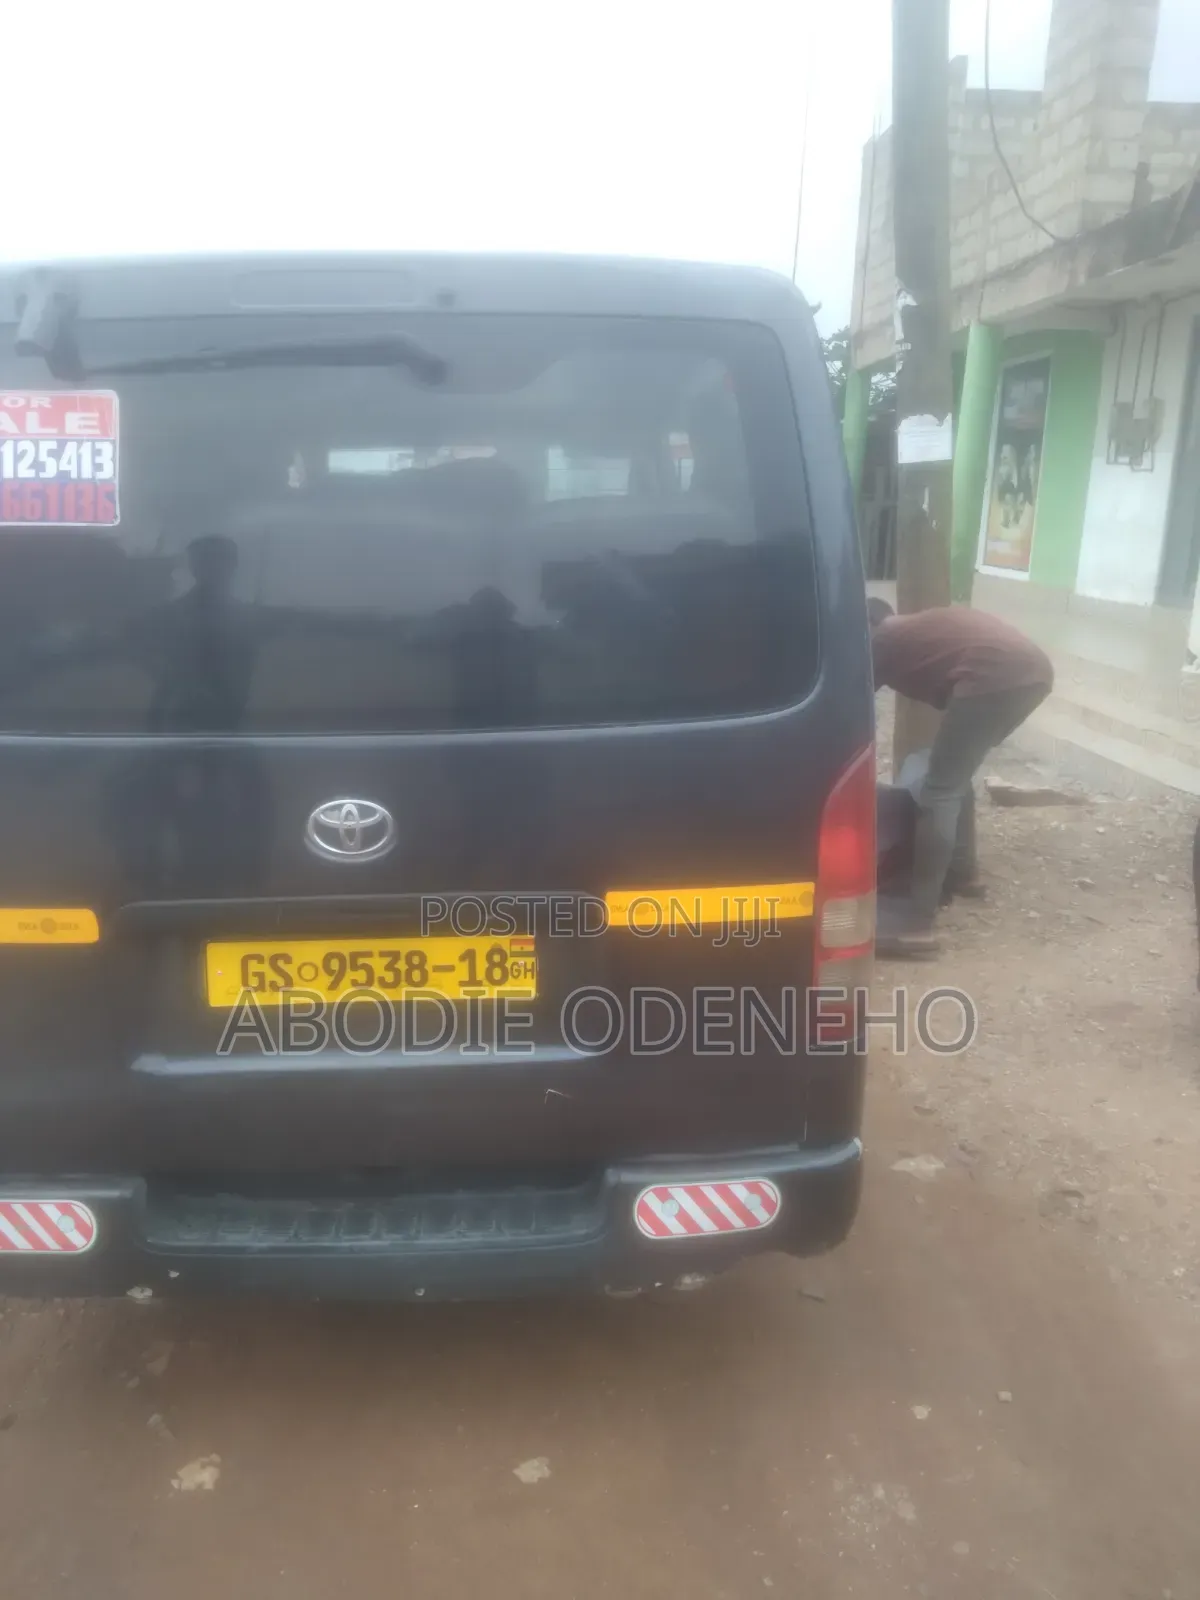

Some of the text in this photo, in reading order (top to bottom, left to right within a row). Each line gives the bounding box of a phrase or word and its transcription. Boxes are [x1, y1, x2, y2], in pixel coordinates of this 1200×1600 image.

[0, 439, 114, 479] 125413
[240, 953, 294, 992] GS
[321, 947, 510, 991] 9538-18
